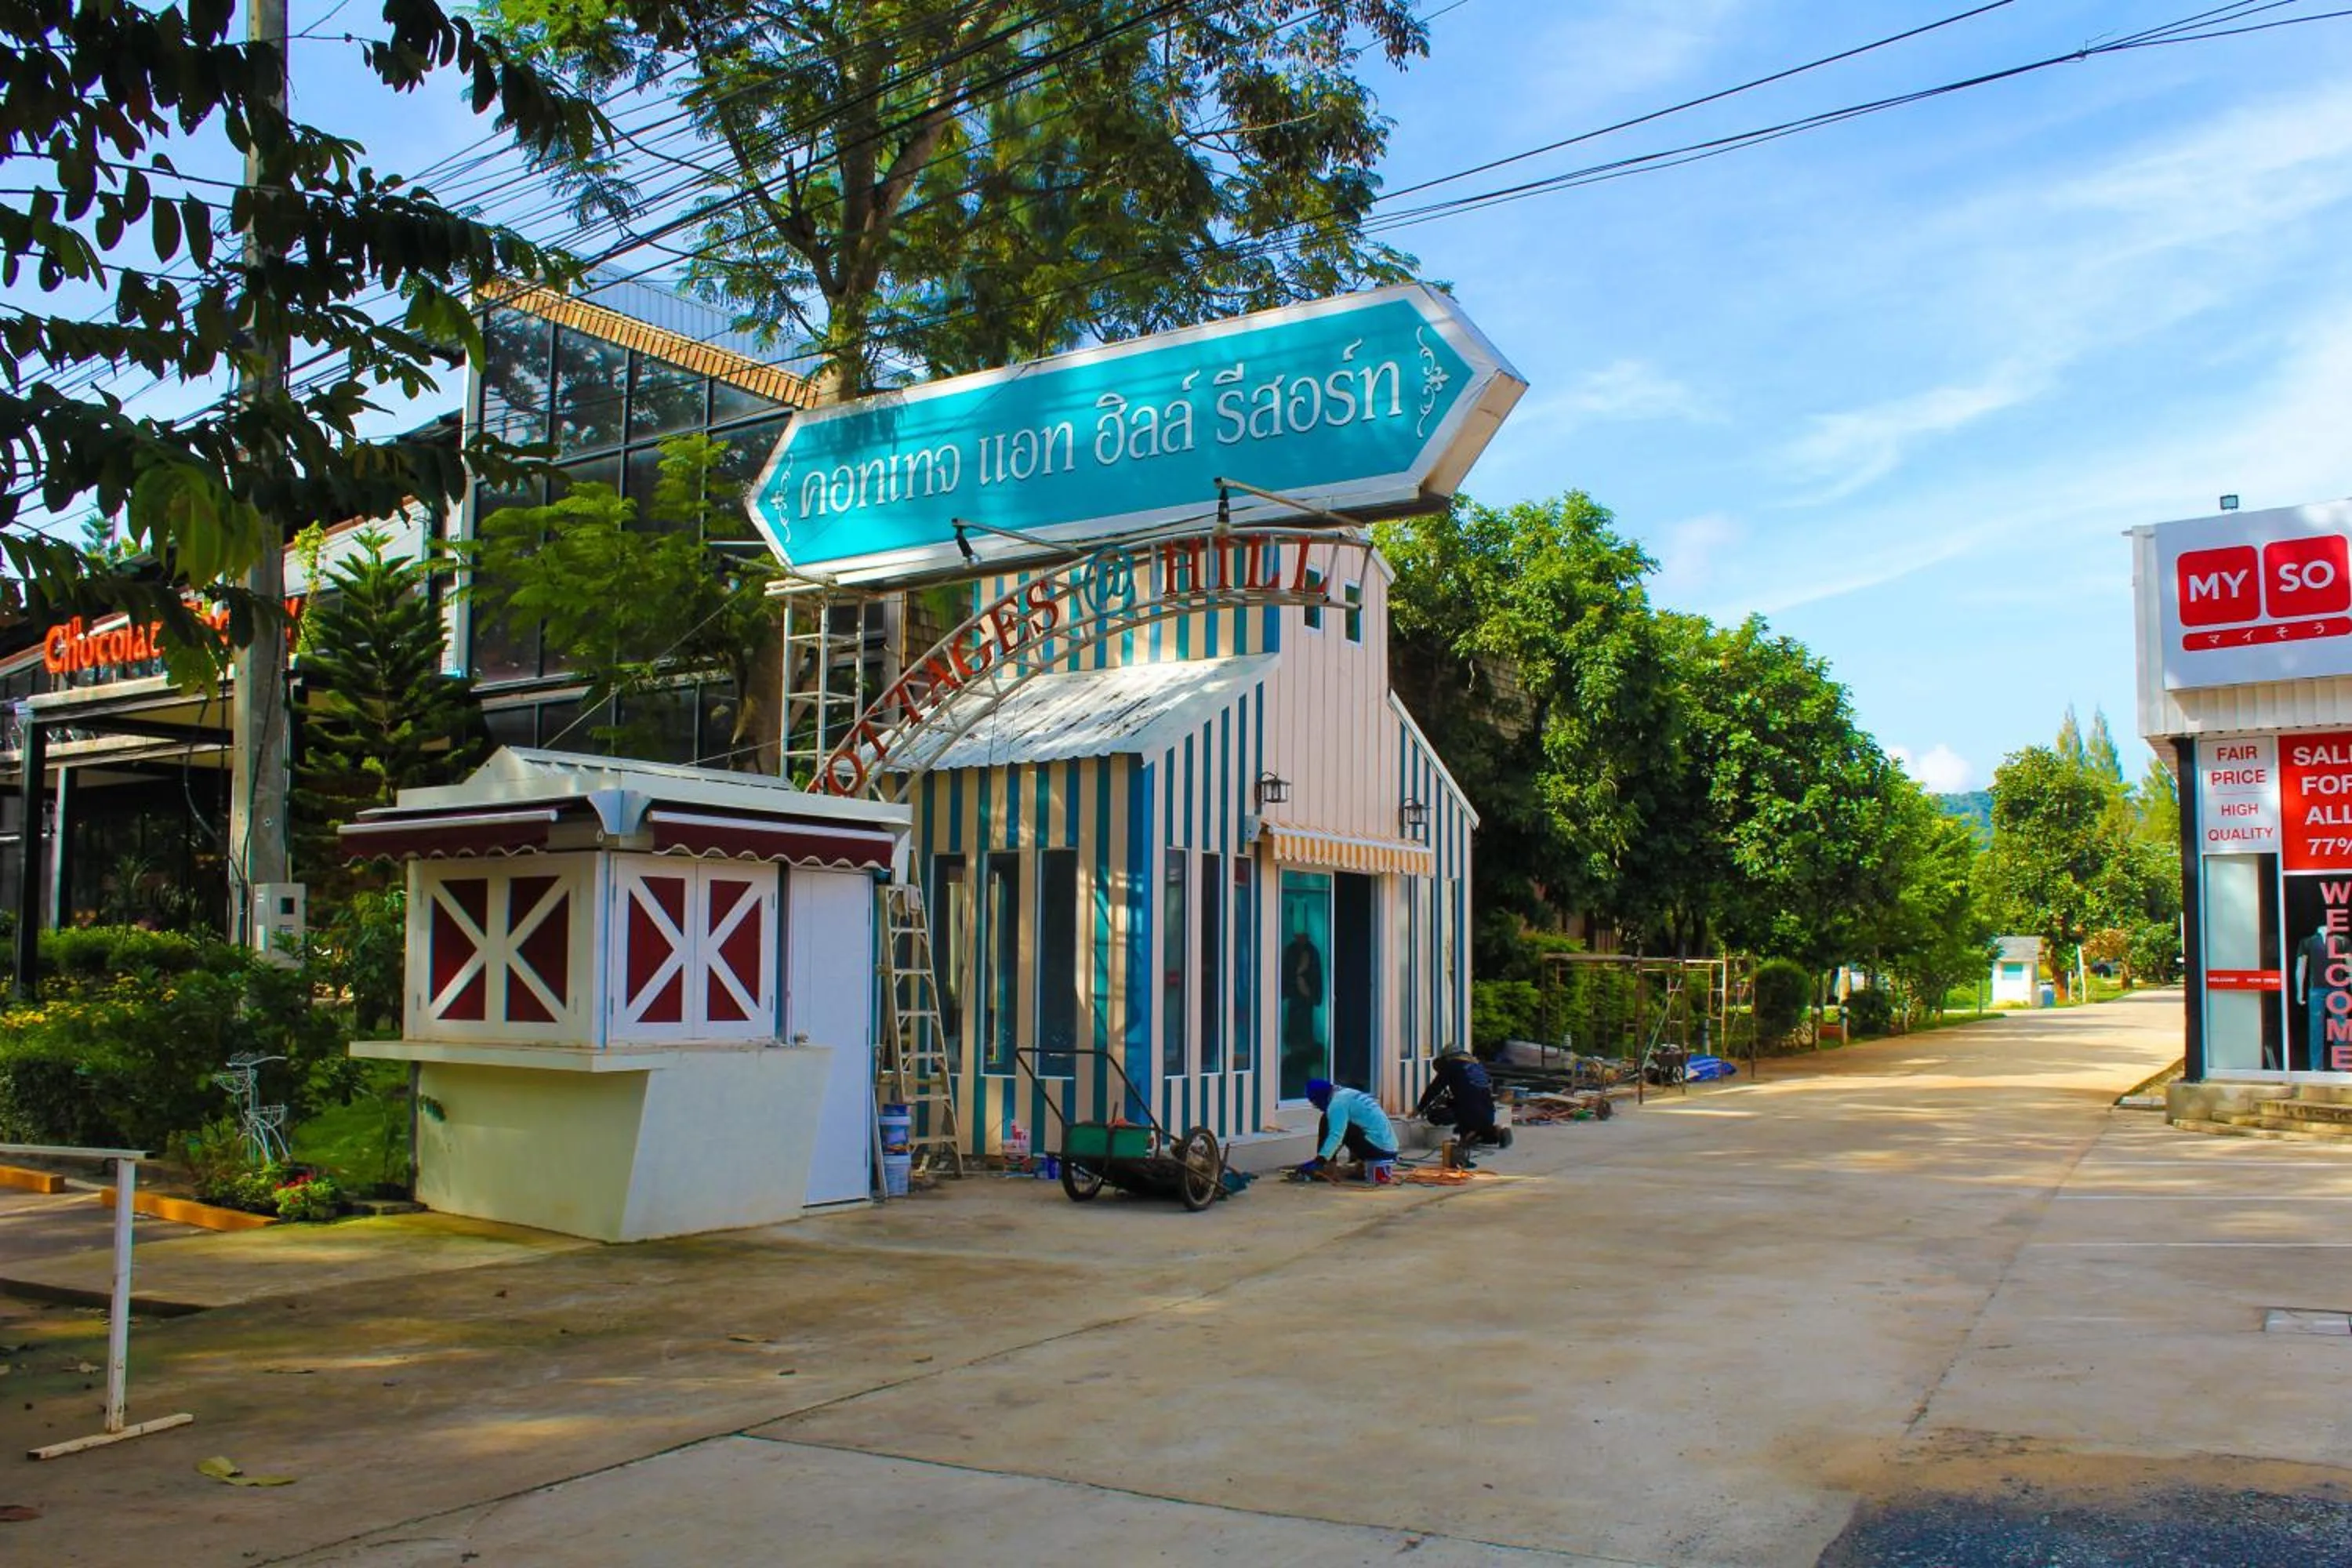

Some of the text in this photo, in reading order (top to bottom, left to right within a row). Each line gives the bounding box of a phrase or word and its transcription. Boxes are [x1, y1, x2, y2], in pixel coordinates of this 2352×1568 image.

[800, 339, 1403, 519] คอทเทจ แอท ฮิลล์ รีสอร์ท
[2188, 560, 2335, 602] MY SO
[807, 579, 1059, 798] OTTAGES
[1164, 533, 1329, 594] HILL
[2216, 746, 2258, 761] FAIR
[2292, 745, 2352, 766] SAL
[2211, 769, 2267, 786] PRICE
[2221, 804, 2259, 816] HIGH
[2208, 827, 2274, 841] QUALITY
